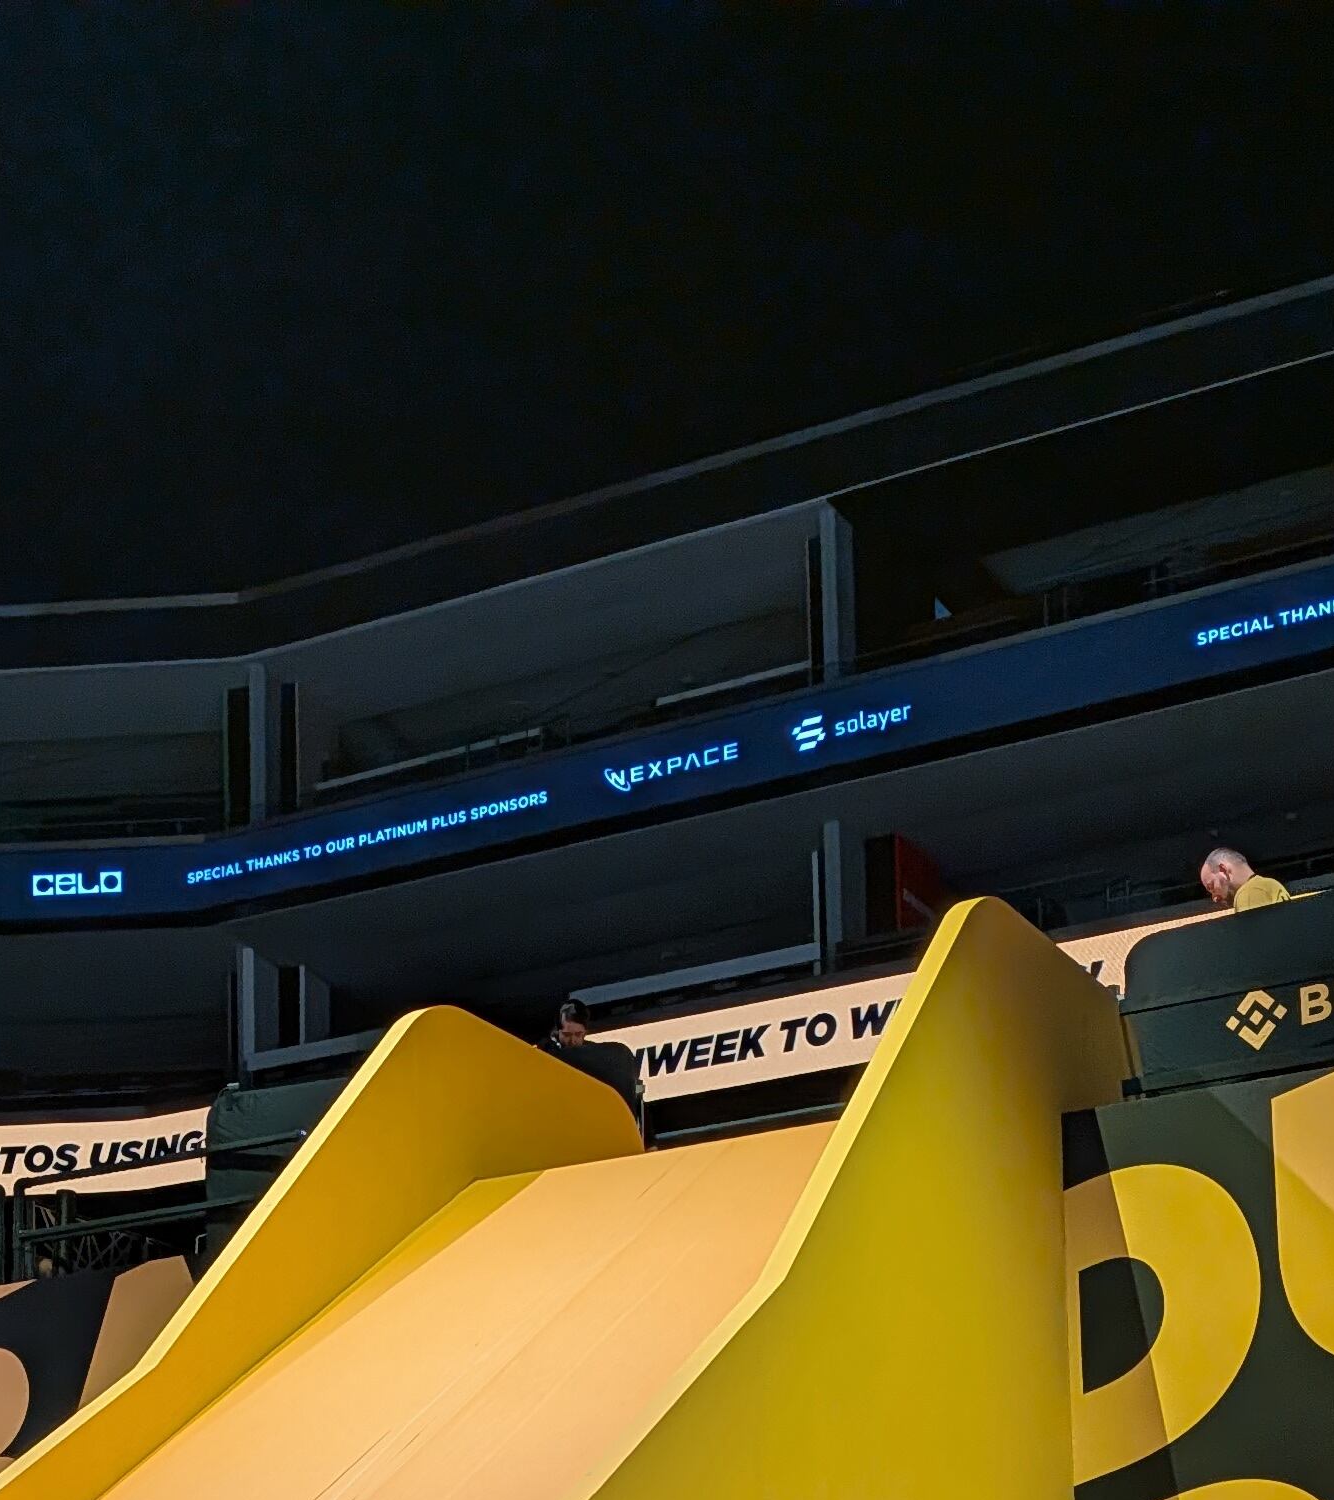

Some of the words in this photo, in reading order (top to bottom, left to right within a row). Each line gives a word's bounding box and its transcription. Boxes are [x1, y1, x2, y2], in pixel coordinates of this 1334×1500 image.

[1196, 615, 1274, 647] SPECIAL
[835, 704, 912, 737] solayer
[604, 742, 739, 791] NEXPACE
[186, 860, 243, 884] SPECIAL
[246, 848, 300, 872] THANKS
[303, 844, 322, 859] TO
[325, 835, 355, 855] OUR
[358, 818, 428, 847] PLATINUM
[431, 809, 467, 831] PLUS
[470, 790, 548, 821] SPONSORS
[779, 1012, 837, 1053] TO
[90, 1130, 205, 1168] USING
